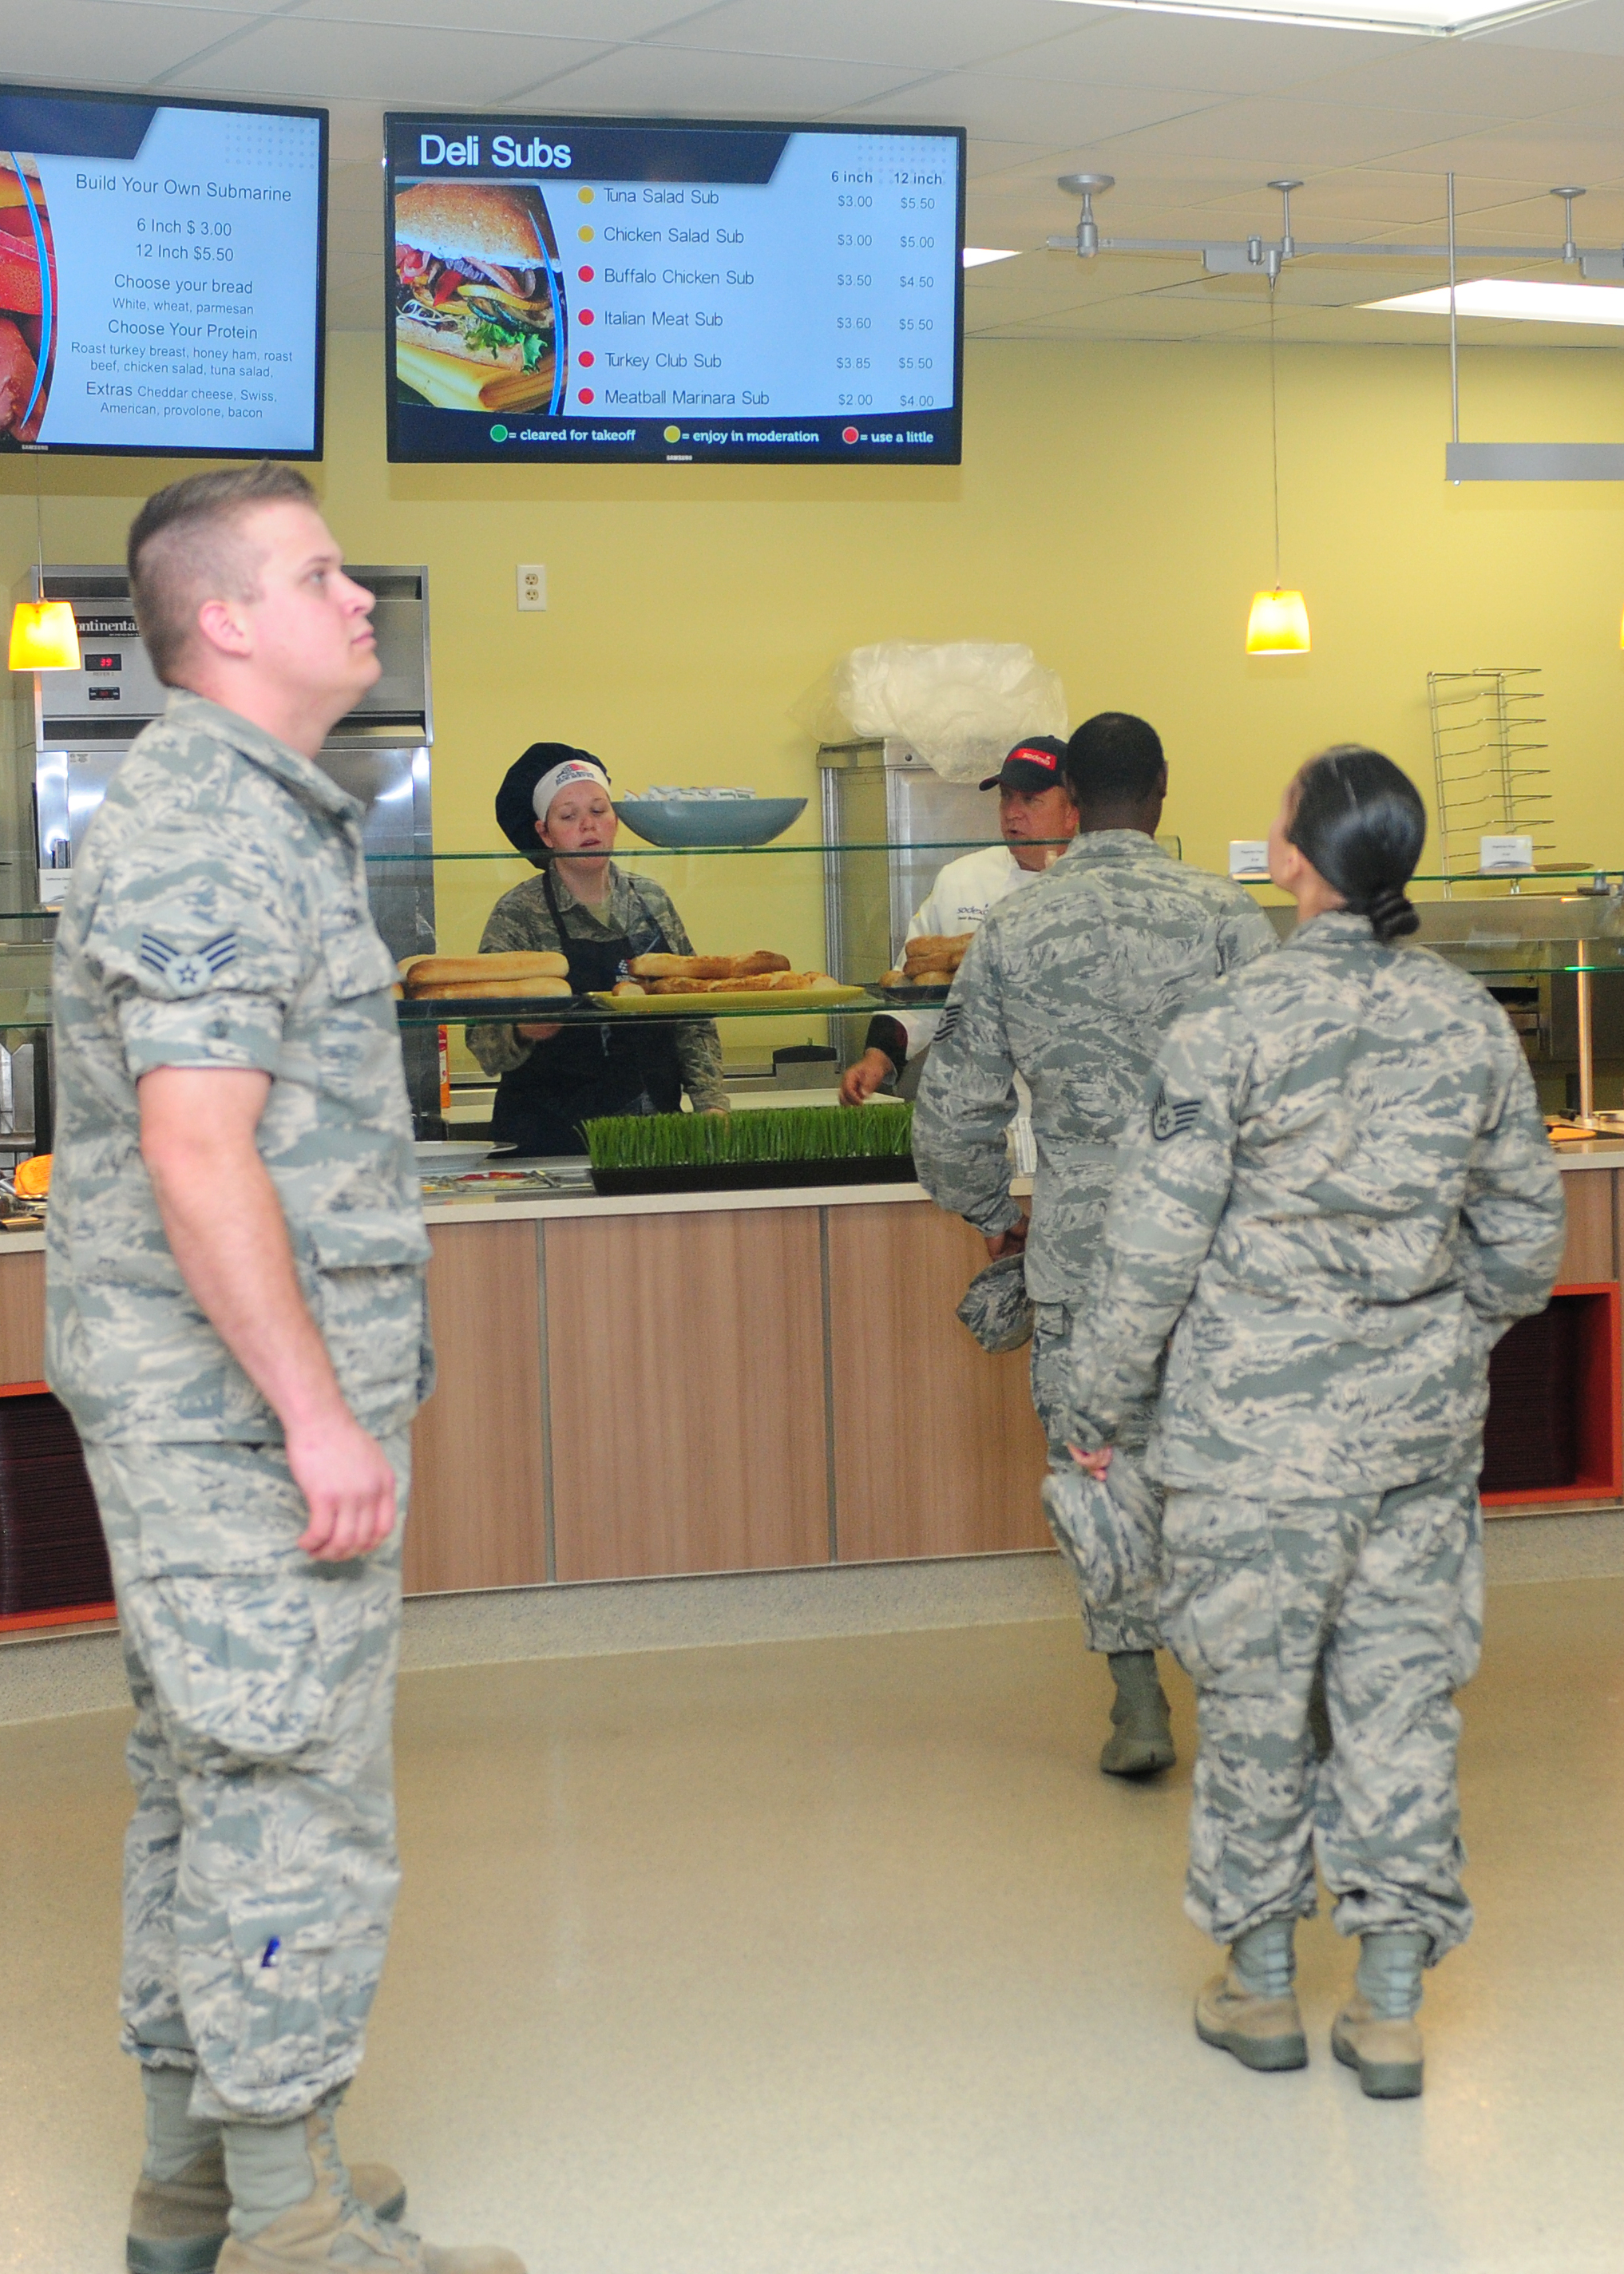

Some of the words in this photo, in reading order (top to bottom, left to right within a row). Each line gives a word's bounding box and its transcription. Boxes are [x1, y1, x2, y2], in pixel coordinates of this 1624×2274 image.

[420, 134, 479, 166] Deli
[491, 135, 572, 168] Subs
[831, 170, 839, 183] 6
[843, 170, 873, 184] inch
[894, 172, 909, 184] 12
[913, 172, 942, 185] inch
[76, 173, 116, 191] Build
[121, 176, 159, 193] Your
[164, 179, 200, 196] Own
[206, 181, 291, 202] Submarine
[604, 188, 636, 203] Tuna
[644, 188, 684, 204] Salad
[691, 189, 719, 204] Sub
[838, 195, 873, 208] $3.00
[901, 196, 935, 210] $5.50
[137, 217, 146, 232] 6
[152, 218, 181, 234] Inch
[187, 220, 196, 235] $
[200, 221, 232, 237] 3.00
[604, 226, 662, 242] Chicken
[667, 228, 710, 244] Salad
[715, 228, 744, 244] Sub
[838, 234, 873, 247] $3.00
[900, 236, 935, 248] $5.00
[136, 244, 152, 258] 12
[158, 244, 188, 259] Inch
[193, 245, 234, 262] $5.50
[604, 267, 656, 283] Buffalo
[662, 269, 720, 284] Chicken
[726, 270, 755, 285] Sub
[837, 274, 872, 287] $3.50
[899, 275, 934, 288] $4.50
[114, 273, 171, 291] Choose
[175, 280, 208, 295] your
[212, 278, 253, 295] bread
[113, 297, 150, 311] White,
[153, 299, 192, 313] wheat,
[196, 303, 254, 315] parmesan
[604, 311, 646, 326] Italian
[652, 311, 689, 327] Meat
[695, 311, 723, 327] Sub
[837, 316, 872, 329] $3.60
[899, 318, 933, 331] $5.50
[108, 319, 165, 335] Choose
[169, 322, 203, 337] Your
[207, 323, 258, 339] Protein
[71, 341, 106, 355] Roast
[109, 343, 146, 359] turkey
[149, 345, 189, 359] breast,
[193, 347, 229, 362] honey
[232, 348, 260, 362] ham,
[264, 351, 292, 362] roast
[90, 359, 120, 373] beef,
[124, 361, 168, 374] chicken
[172, 362, 207, 376] salad,
[210, 364, 236, 376] tuna
[239, 366, 274, 379] salad,
[604, 352, 650, 371] Turkey
[656, 352, 688, 368] Club
[693, 353, 722, 368] Sub
[836, 356, 871, 370] $3.85
[898, 357, 933, 370] $5.50
[86, 381, 133, 397] Extras
[137, 386, 188, 398] Cheddar
[191, 388, 236, 402] cheese,
[240, 389, 277, 402] Swiss,
[605, 389, 667, 404] Meatball
[672, 390, 735, 405] Marinara
[742, 390, 770, 406] Sub
[838, 394, 873, 406] $2.00
[900, 394, 934, 407] $4.00
[100, 402, 160, 416] American,
[164, 405, 224, 419] provolone,
[228, 406, 263, 418] bacon
[519, 428, 568, 441] cleared
[569, 429, 589, 441] for
[591, 429, 636, 442] takeoff
[692, 430, 729, 445] enjoy
[731, 430, 744, 442] in
[746, 430, 820, 442] moderation
[870, 433, 893, 443] use
[895, 433, 905, 443] a
[905, 430, 934, 443] little
[76, 619, 140, 632] ontinenta
